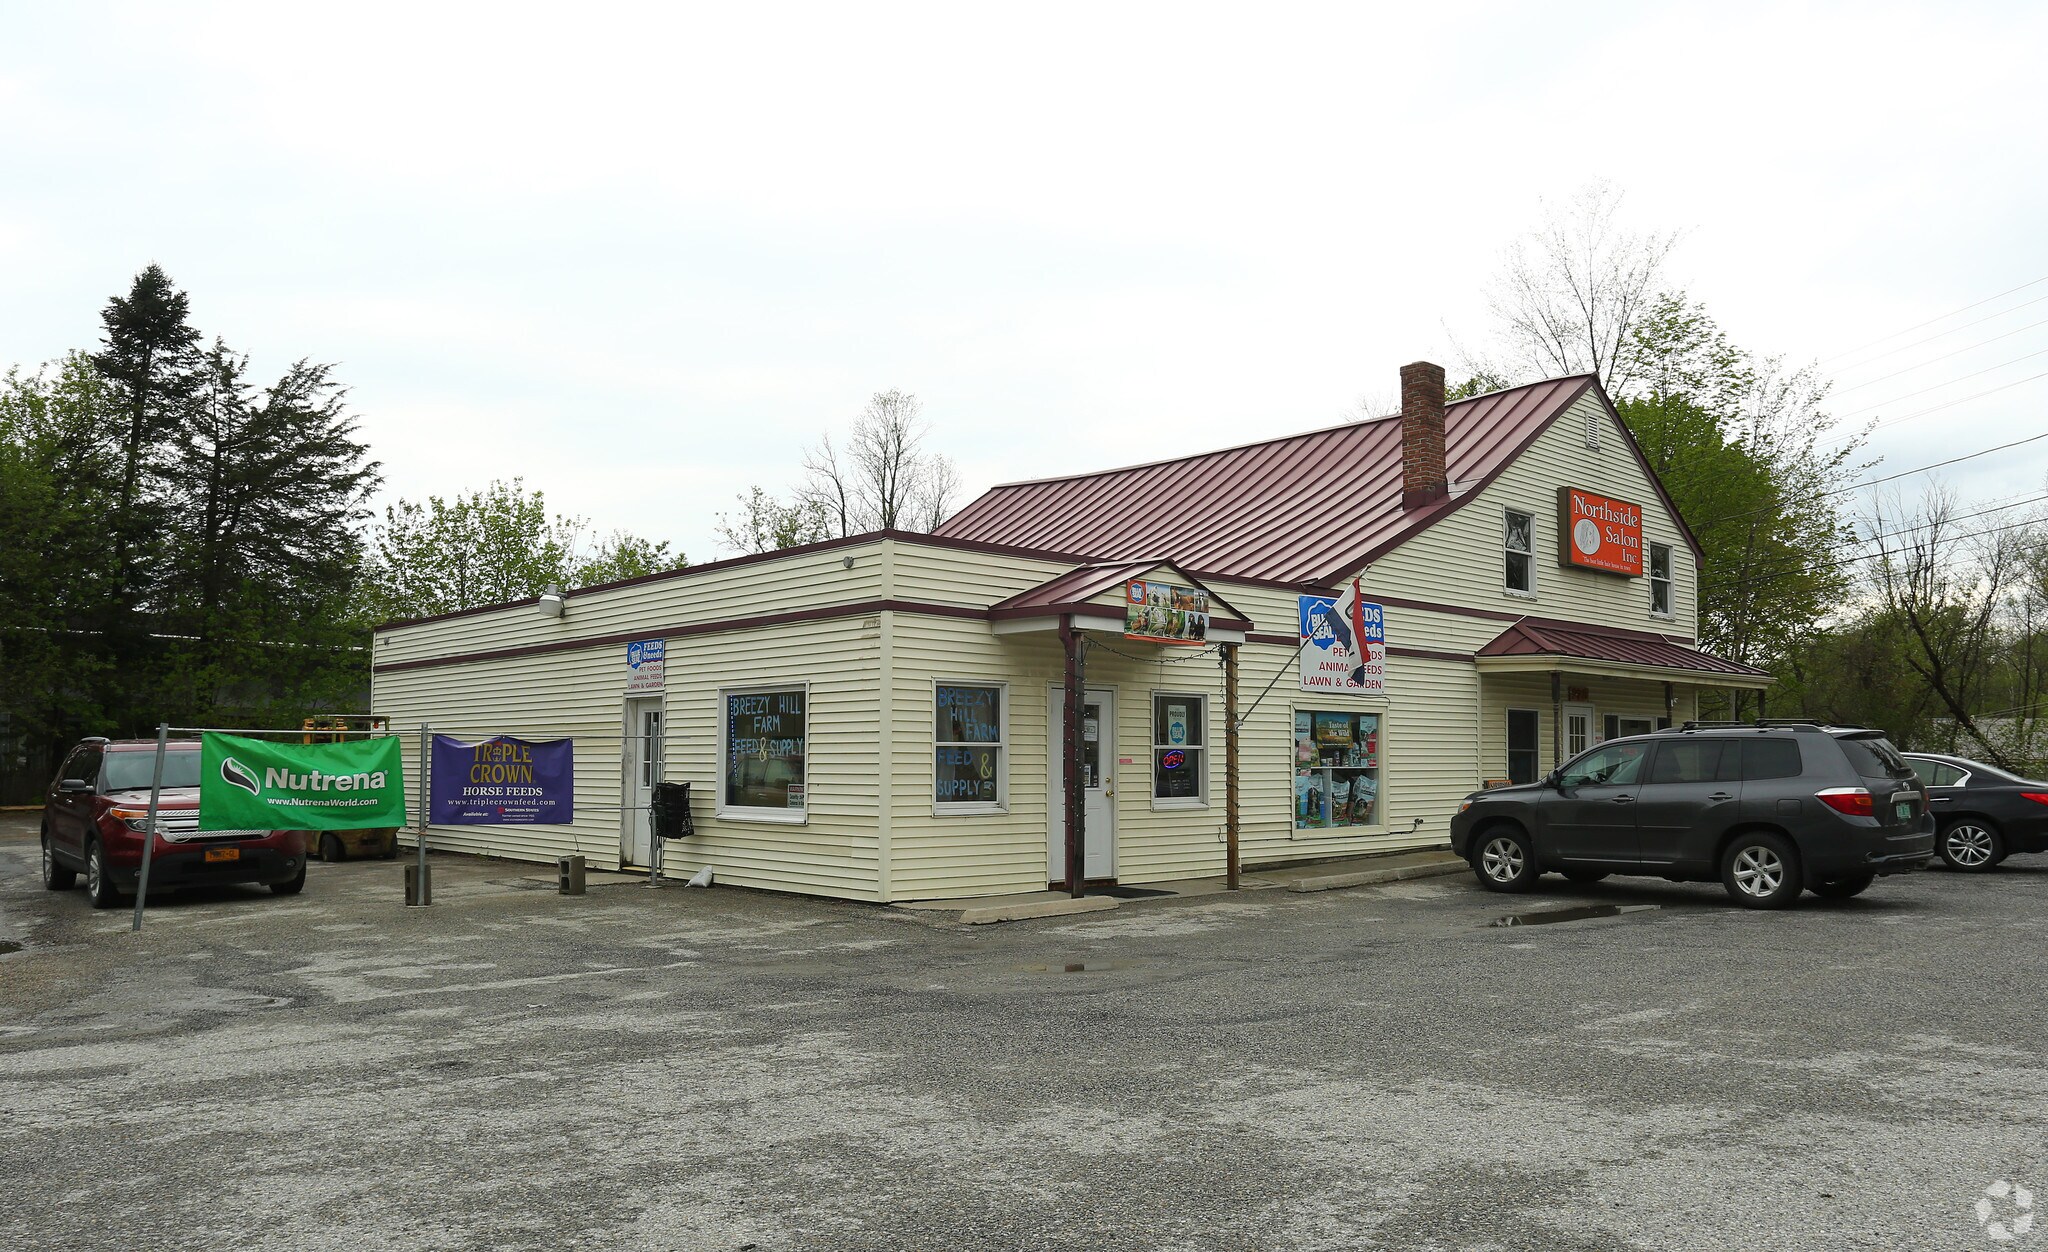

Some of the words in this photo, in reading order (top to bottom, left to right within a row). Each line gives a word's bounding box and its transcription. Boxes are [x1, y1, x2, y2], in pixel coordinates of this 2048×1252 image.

[1573, 494, 1638, 528] Northside
[1605, 525, 1639, 549] Salon
[1622, 548, 1640, 565] Inc.
[643, 641, 662, 651] FEEDS
[1333, 647, 1348, 658] PET
[1303, 675, 1331, 687] LAWN
[1335, 677, 1342, 687] &
[733, 695, 770, 716] BREEZY
[779, 694, 801, 715] HILL
[937, 687, 994, 707] BREEZY
[950, 706, 977, 723] HILL
[754, 715, 780, 734] FARM
[965, 723, 998, 741] FARM
[1329, 721, 1342, 729] Taste
[1343, 721, 1349, 729] of
[1329, 729, 1338, 737] the
[1338, 729, 1350, 737] Wild
[735, 738, 758, 754] FEED
[759, 736, 768, 762] &
[769, 738, 804, 758] SUPPLY
[937, 749, 972, 765] FEED
[980, 753, 993, 779] &
[1163, 754, 1185, 767] OPEN
[470, 763, 533, 784] CROWN
[462, 786, 503, 797] HORSE
[506, 786, 543, 797] FEEDS
[937, 779, 981, 796] SUPPLY
[267, 797, 378, 808] www.NutrenaWorld.com
[447, 799, 556, 807] www.triplecrownfeed.com
